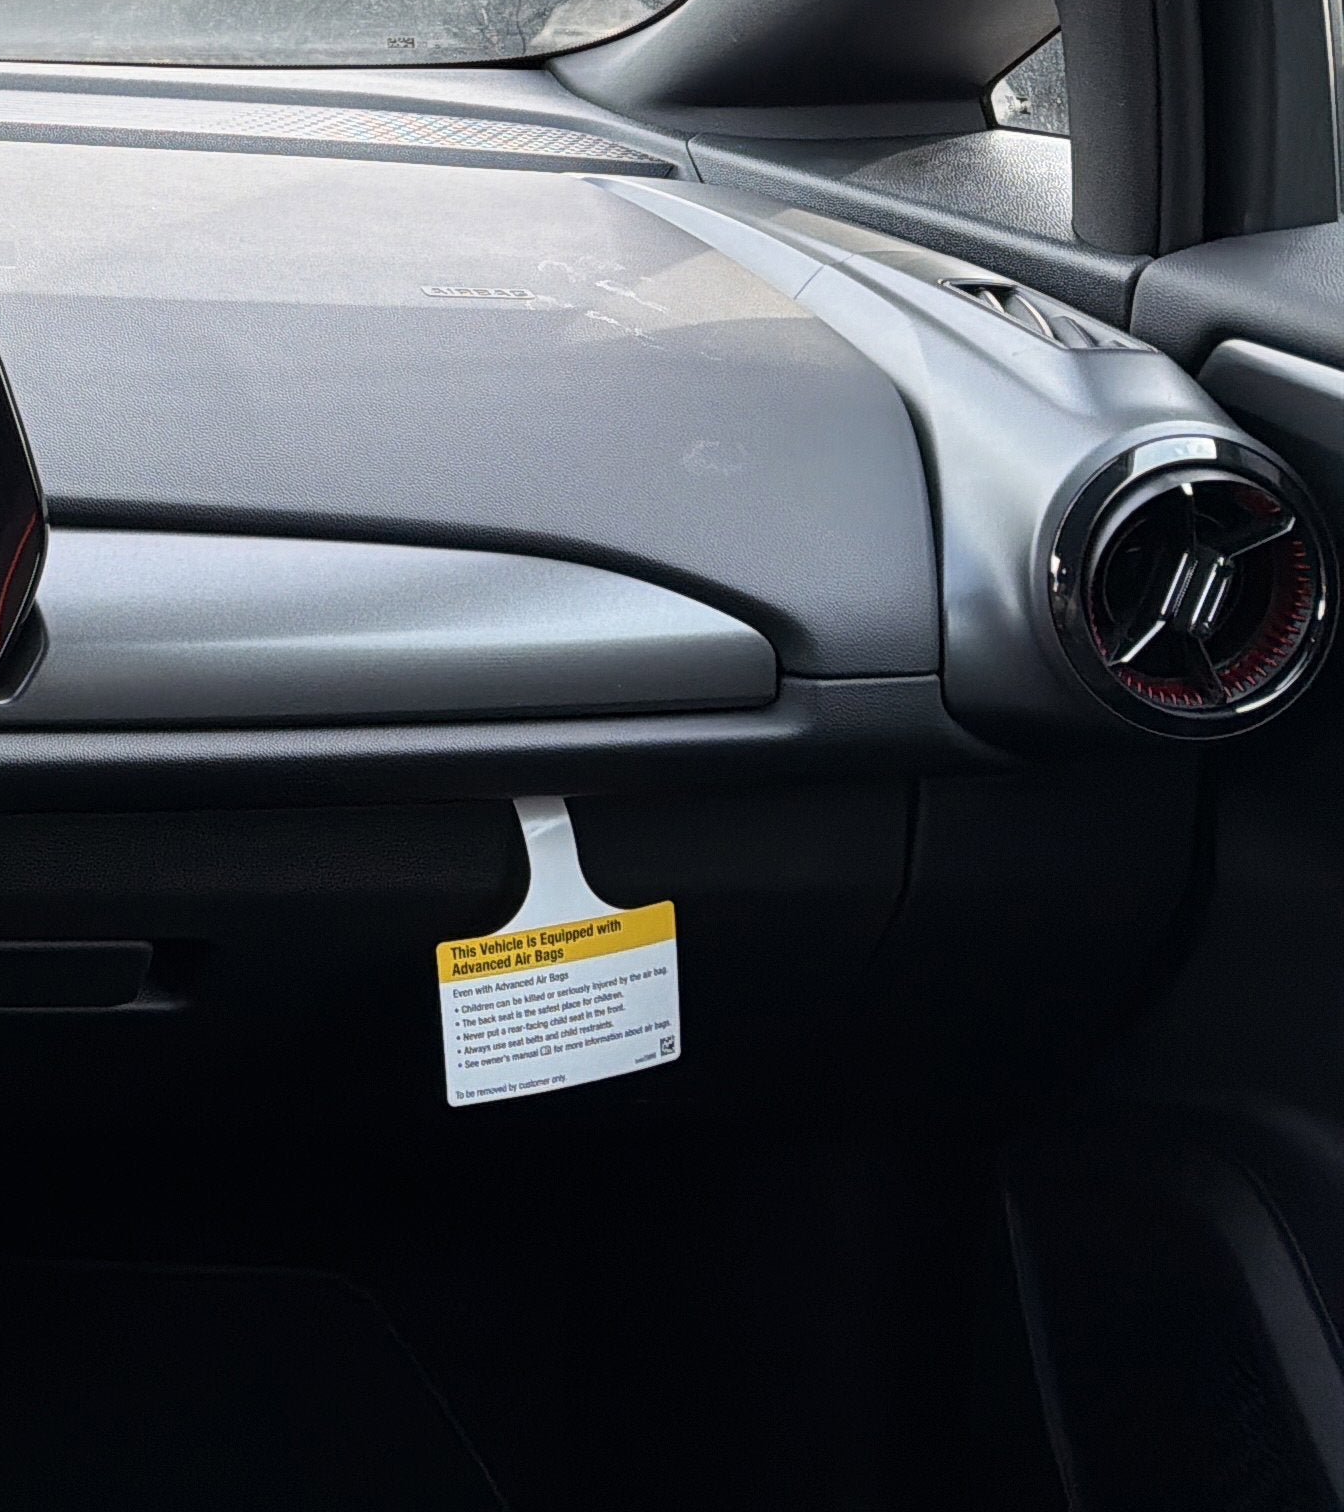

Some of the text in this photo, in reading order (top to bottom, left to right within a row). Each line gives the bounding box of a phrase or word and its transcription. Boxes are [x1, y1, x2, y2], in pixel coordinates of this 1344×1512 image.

[450, 919, 622, 961] This Vehicle is Equipped with
[452, 947, 564, 977] Advanced Air Bags
[453, 971, 569, 999] Even with Advanced Air Bags
[461, 969, 652, 1014] Children can be killed or seriously injured by the air
[462, 1018, 477, 1028] The
[478, 1014, 496, 1026] back
[498, 1011, 515, 1022] seat
[515, 1010, 523, 1019] is
[524, 1008, 537, 1017] the
[537, 1003, 561, 1015] safest
[561, 1000, 582, 1012] place
[582, 997, 593, 1007] for
[462, 1031, 485, 1042] Never
[486, 1028, 500, 1039] put
[507, 1020, 549, 1034] rear-facing
[550, 1015, 568, 1026] child
[568, 1012, 585, 1023] seat
[585, 1010, 593, 1019] in
[594, 1007, 606, 1017] the
[464, 1043, 491, 1055] Always
[492, 1041, 507, 1050] use
[508, 1037, 525, 1047] seat
[525, 1034, 544, 1045] belts
[544, 1031, 559, 1041] and
[560, 1027, 578, 1038] child
[464, 1023, 653, 1070] See owner's manual for more information about air
[456, 1077, 550, 1100] To be removed by customer
